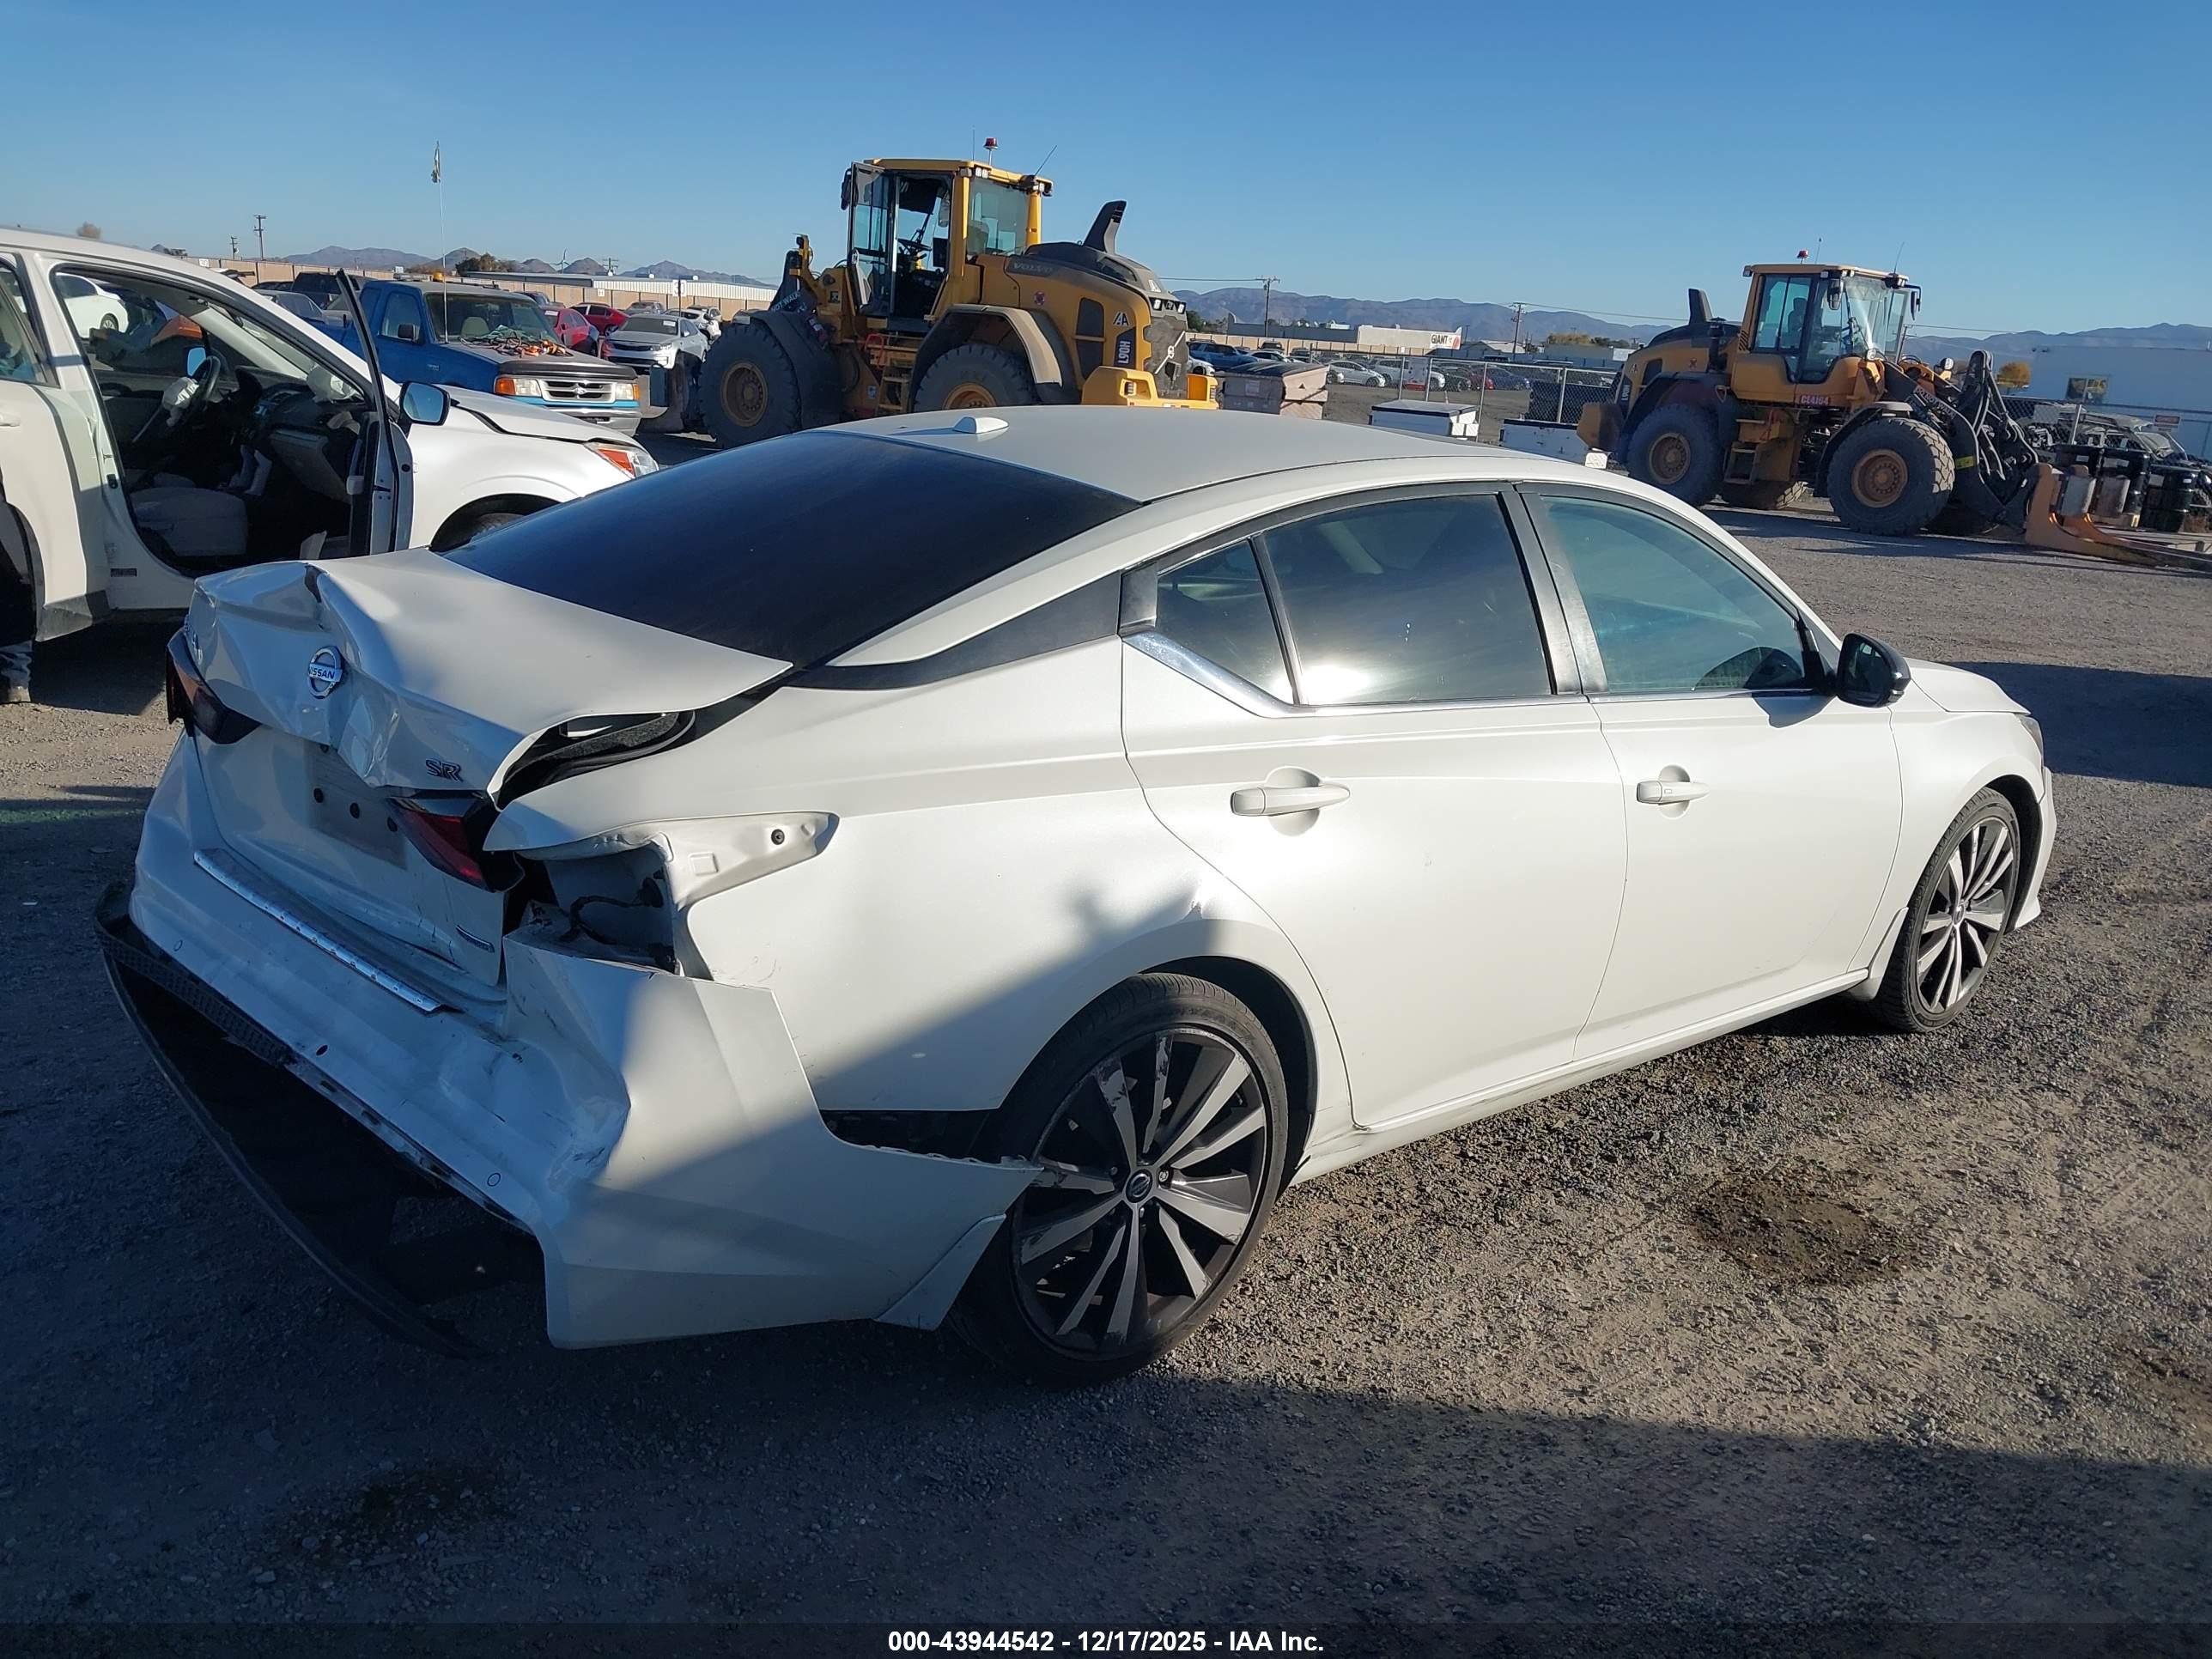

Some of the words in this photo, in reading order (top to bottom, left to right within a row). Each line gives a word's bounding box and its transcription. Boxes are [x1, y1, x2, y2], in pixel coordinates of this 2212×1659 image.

[1431, 334, 1448, 344] GIANT
[1117, 340, 1131, 364] L90H
[310, 665, 336, 679] NISSAN
[426, 758, 464, 782] SR
